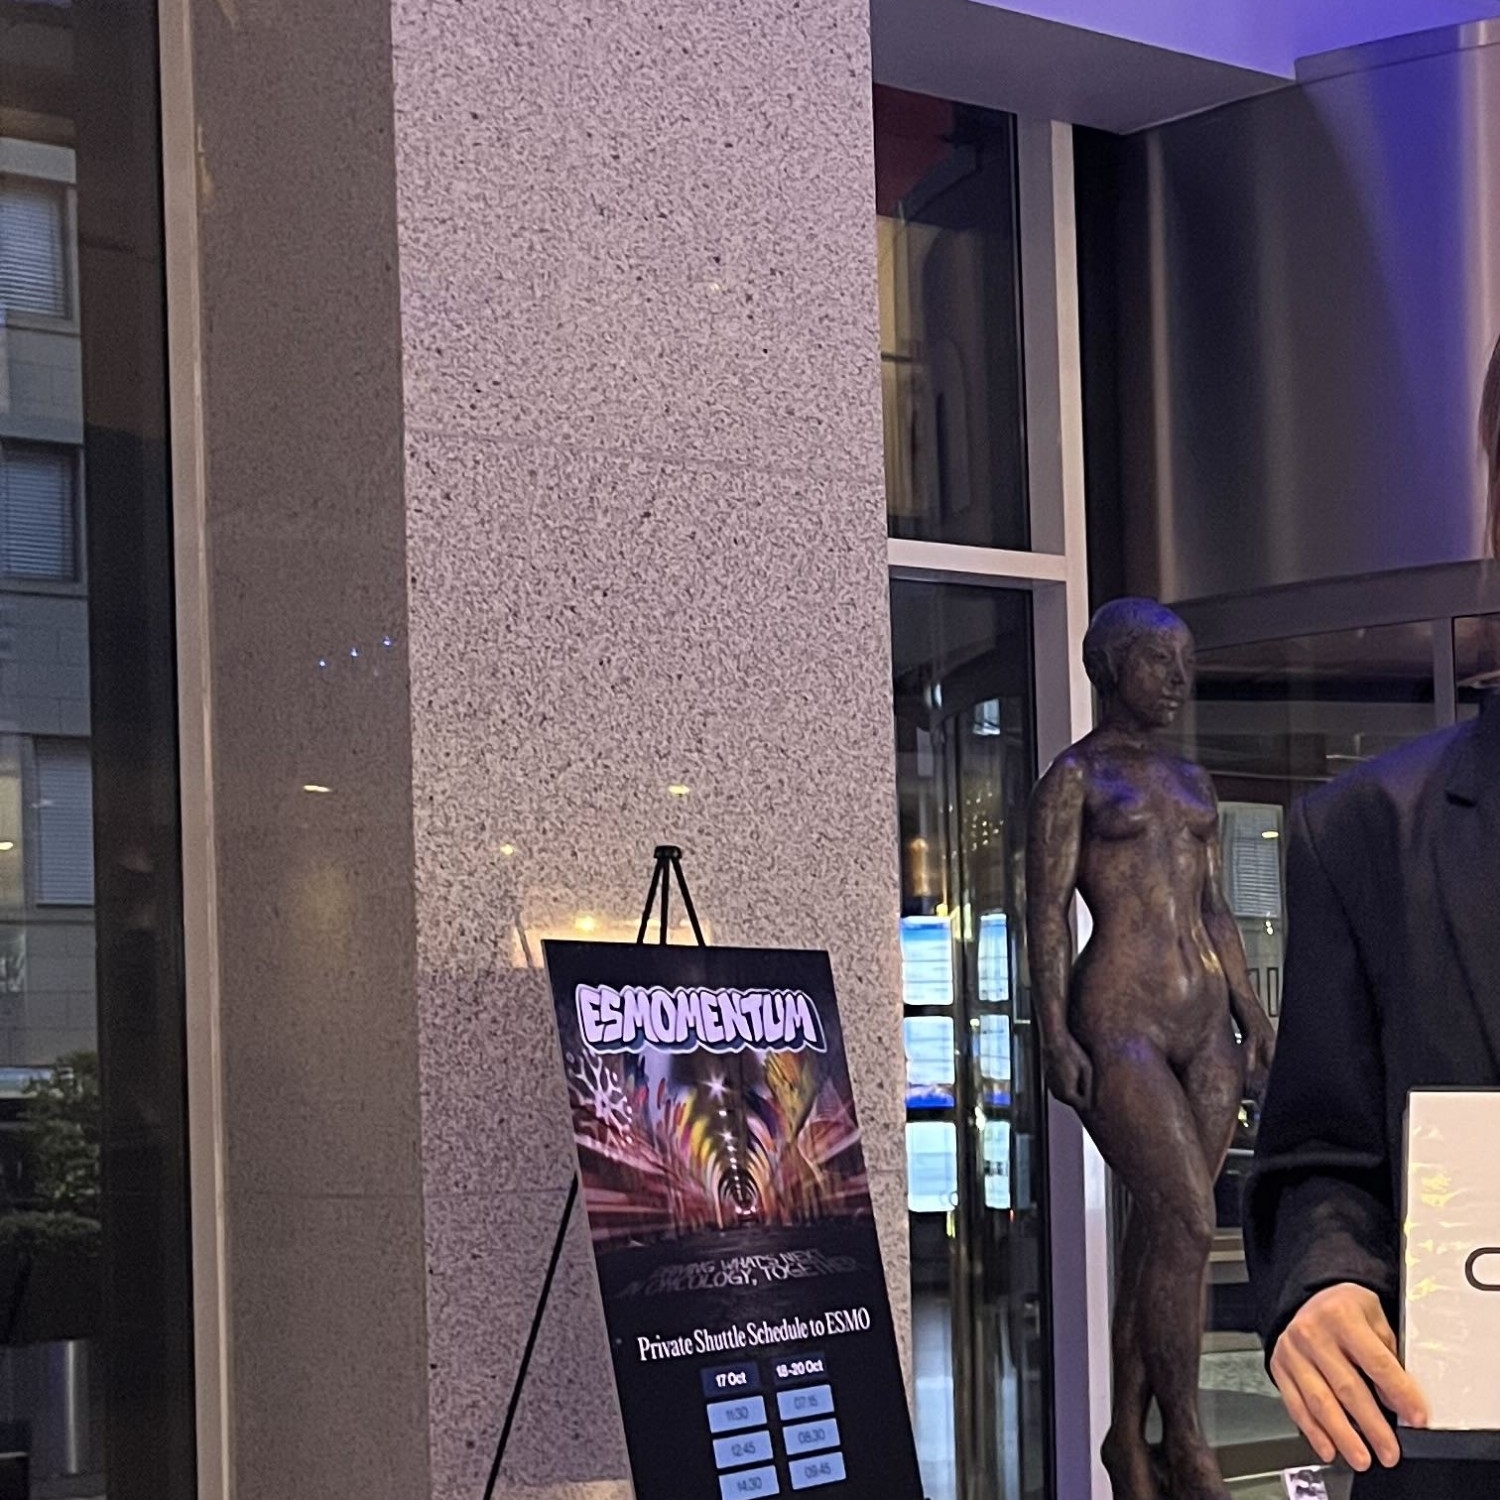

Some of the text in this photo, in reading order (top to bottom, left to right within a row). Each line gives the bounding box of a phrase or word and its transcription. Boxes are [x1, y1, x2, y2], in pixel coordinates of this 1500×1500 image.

[577, 985, 821, 1047] ESMOMENTUM
[637, 1307, 871, 1361] Private Shuttle Schedule to ESMO
[715, 1371, 747, 1388] 17 Oct
[776, 1359, 824, 1378] 18-20 Oct
